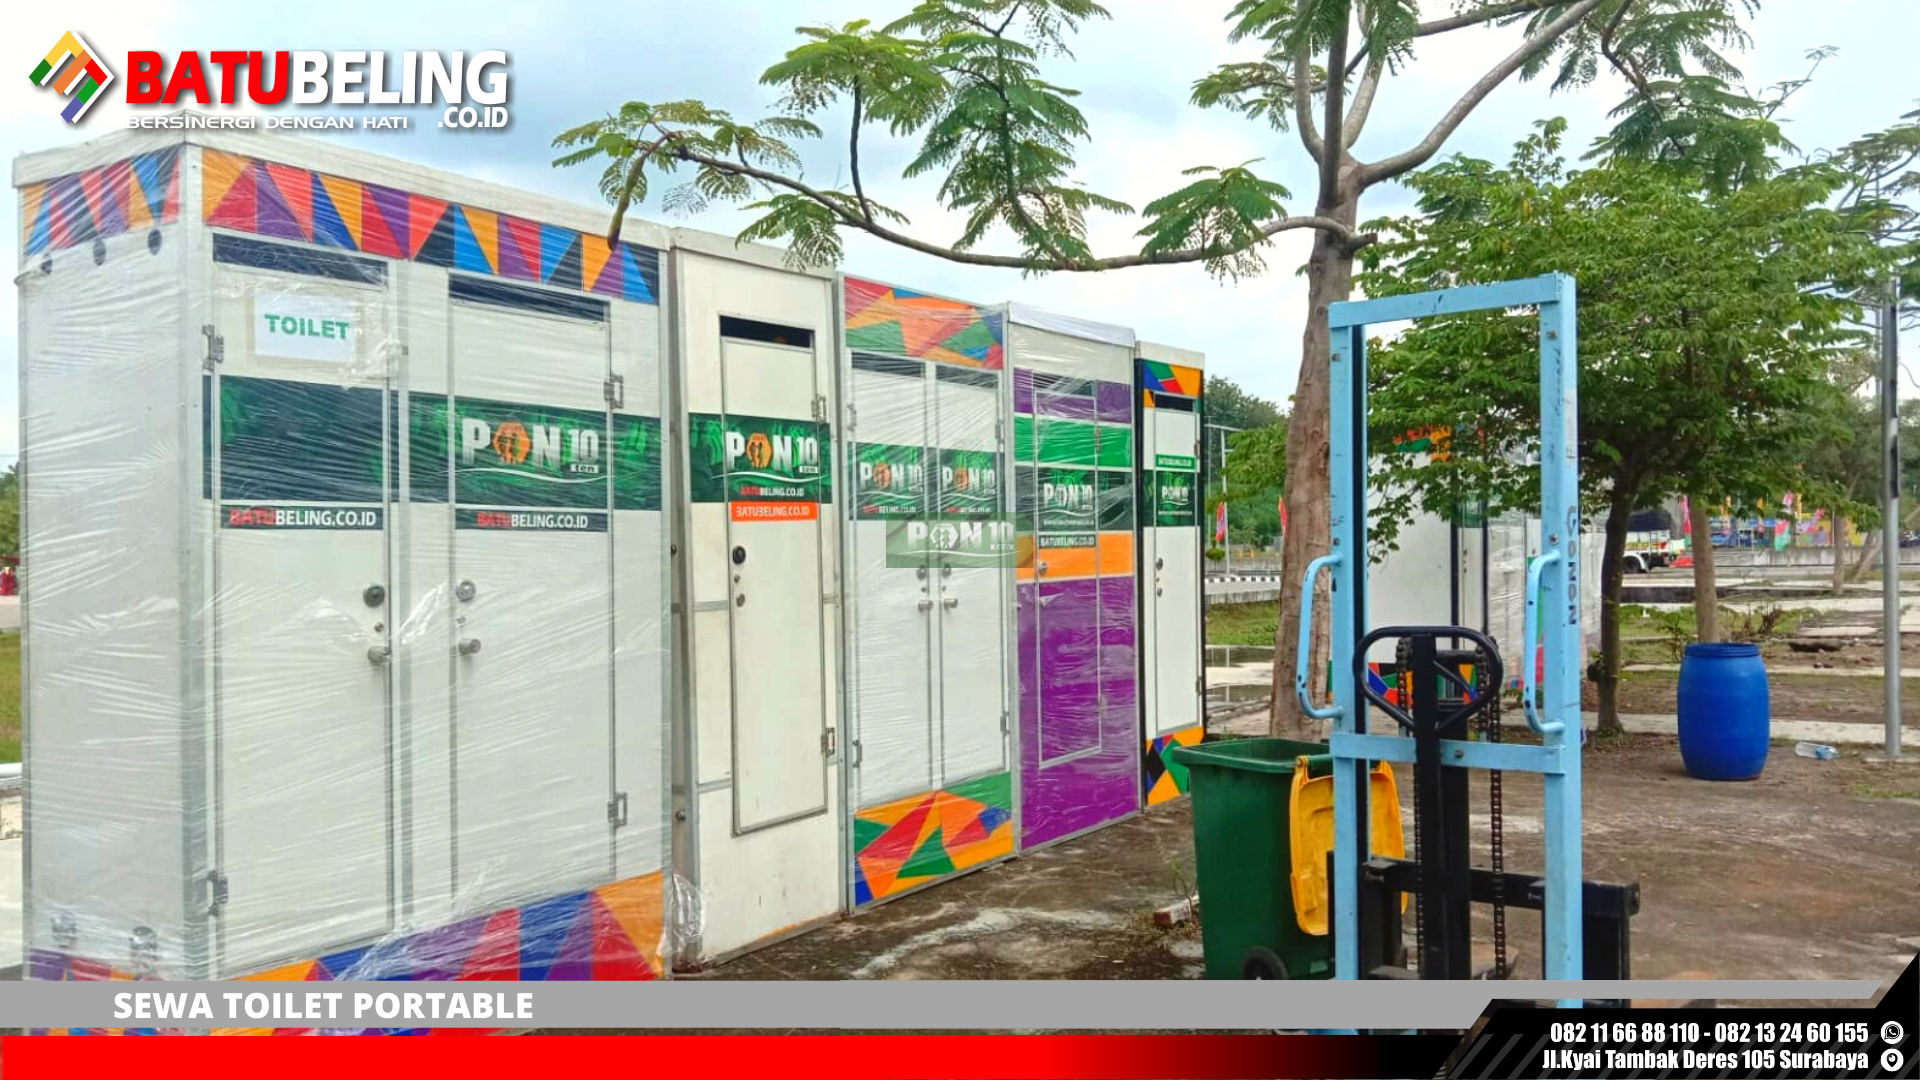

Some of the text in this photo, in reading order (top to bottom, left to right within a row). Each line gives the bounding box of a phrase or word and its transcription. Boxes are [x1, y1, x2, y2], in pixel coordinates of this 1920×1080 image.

[264, 313, 350, 340] TOILET
[567, 428, 599, 464] 10
[796, 436, 818, 465] 10
[229, 508, 377, 527] BATUBELING.CO.ID
[476, 512, 589, 529] BATUBELING.CO.ID
